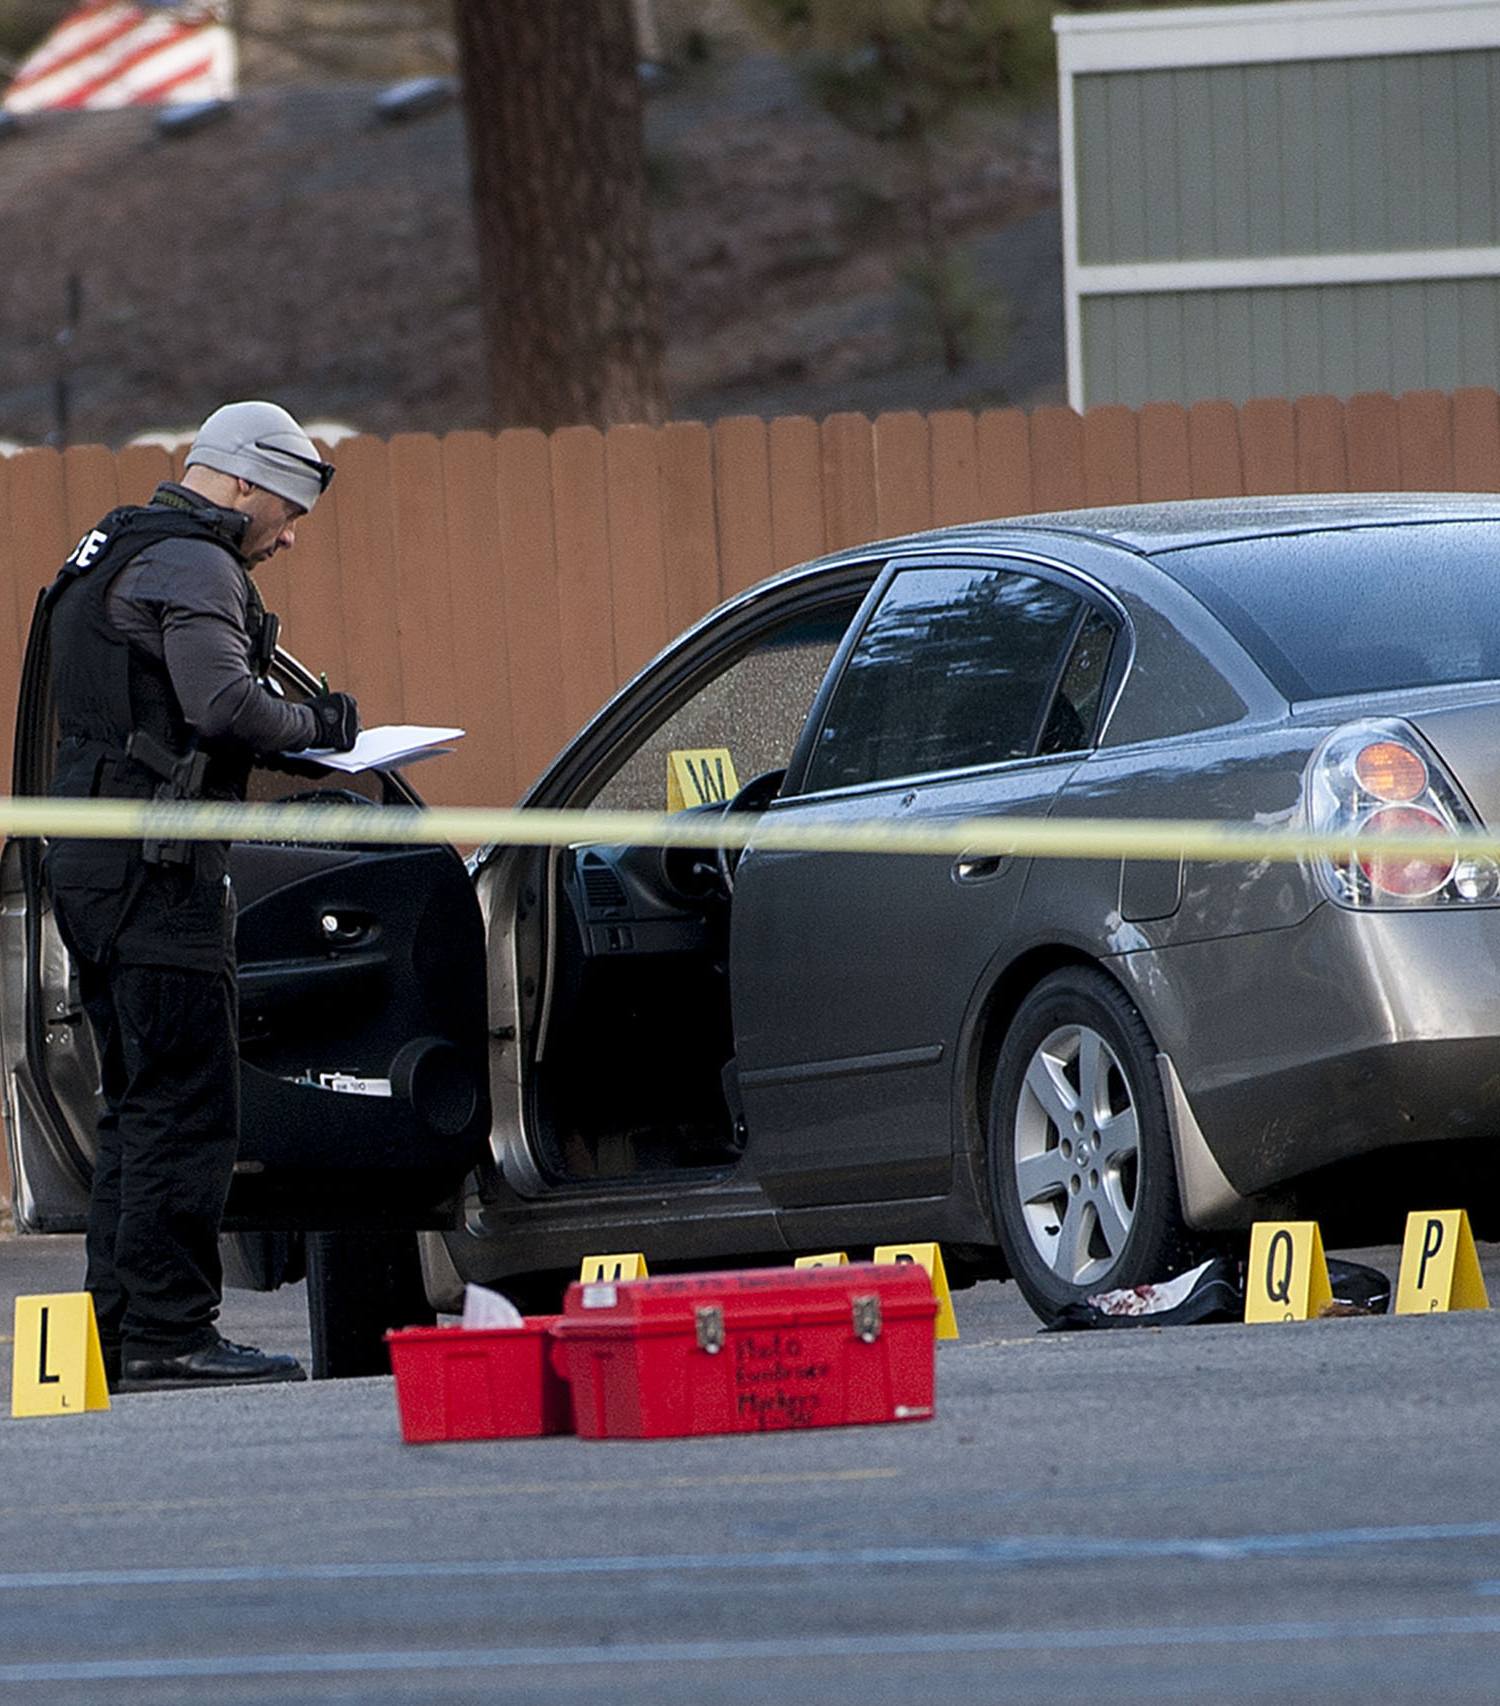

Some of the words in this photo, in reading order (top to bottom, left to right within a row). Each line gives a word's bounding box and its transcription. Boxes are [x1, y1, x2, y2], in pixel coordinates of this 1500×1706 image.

[685, 758, 727, 804] W
[1266, 1229, 1293, 1306] Q
[1417, 1219, 1444, 1290] P
[1430, 1299, 1439, 1312] P
[38, 1307, 60, 1384] L
[61, 1394, 70, 1408] L
